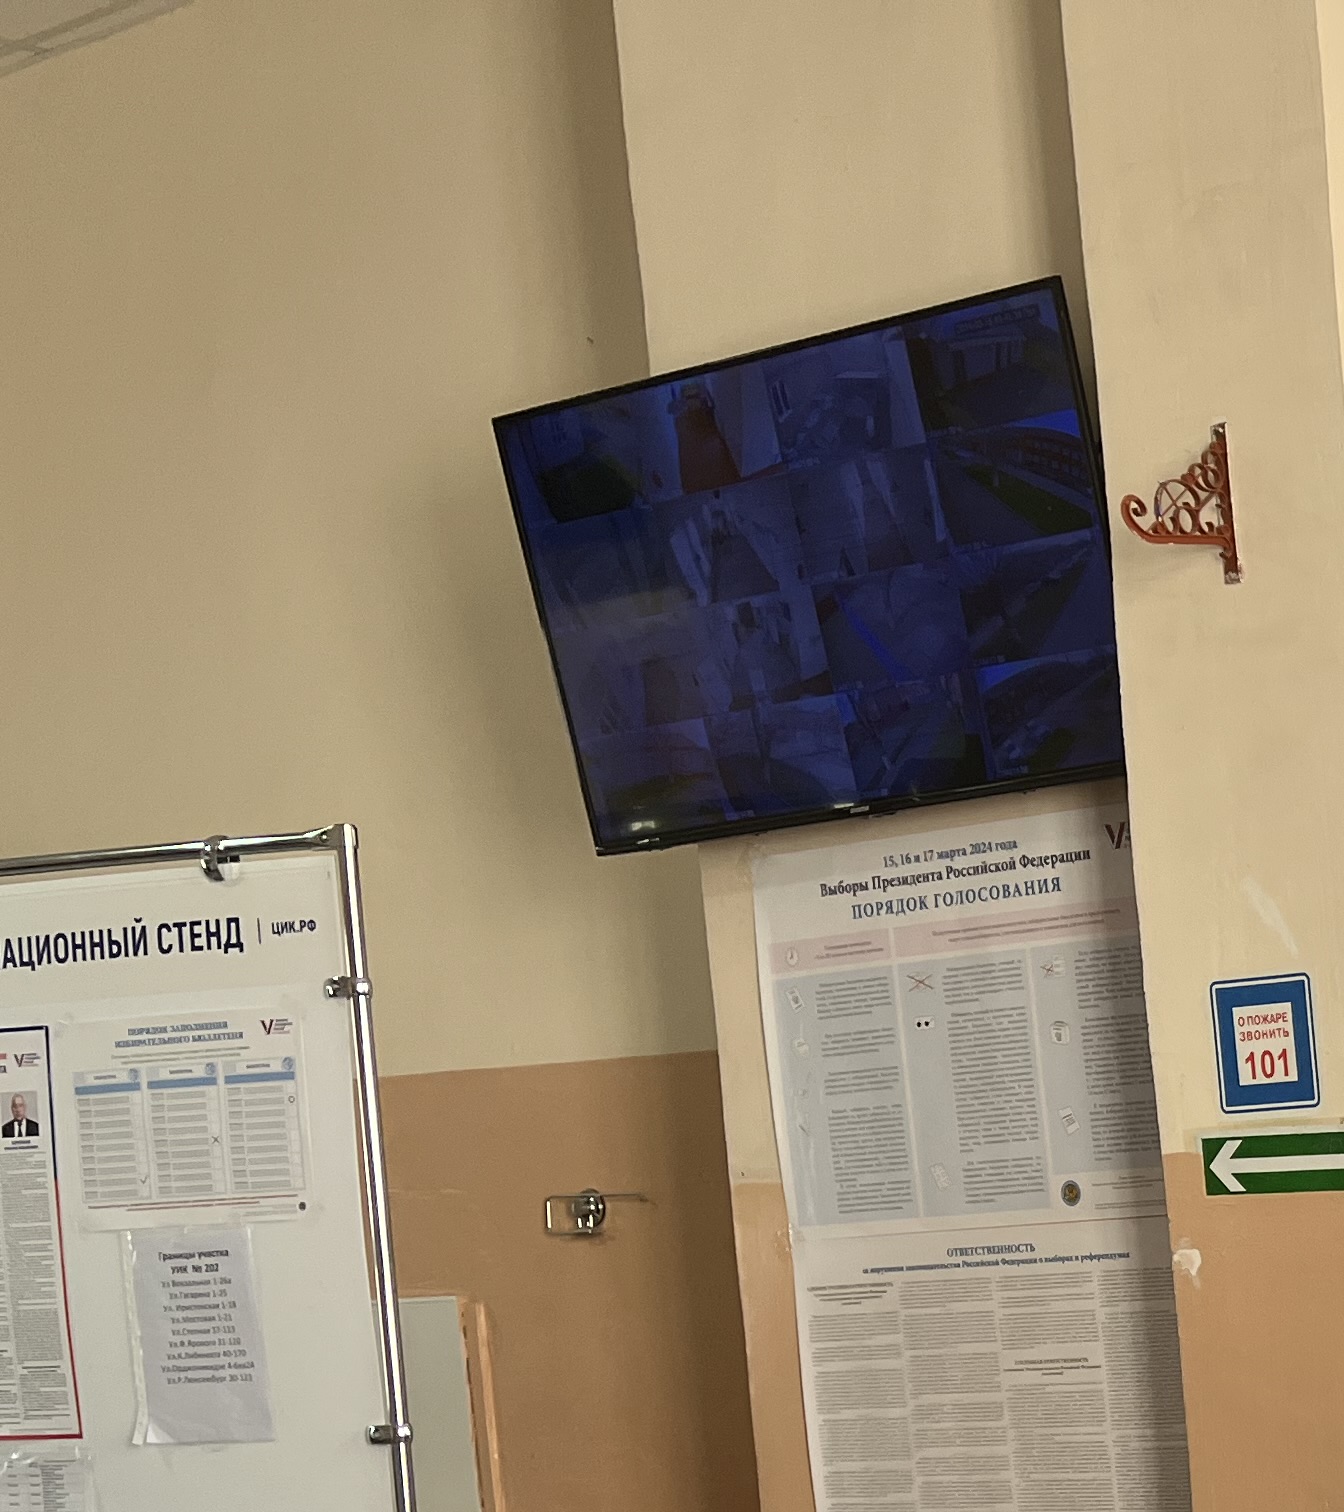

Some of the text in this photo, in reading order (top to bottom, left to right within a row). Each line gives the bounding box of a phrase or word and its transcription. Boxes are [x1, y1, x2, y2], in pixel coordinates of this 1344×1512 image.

[883, 855, 898, 868] 15,
[900, 853, 911, 865] 16
[923, 850, 933, 862] 17
[936, 847, 967, 861] марта
[970, 842, 992, 855] 2024
[995, 840, 1017, 851] года
[820, 850, 1091, 897] Выборы Президента Российской Федерации
[852, 877, 1062, 919] ПОРЯДОК ГОЛОСОВАНИЯ
[2, 917, 317, 972] АЦИОННЫЙ СТЕНД ЦИК.РФ
[1238, 1012, 1289, 1027] О ПОЖАРЕ
[1239, 1027, 1289, 1042] ЗВОНИТЬ
[1244, 1048, 1289, 1080] 101
[947, 1243, 1035, 1257] ОТВЕТСТВЕННОСТЬ
[171, 1263, 219, 1274] УИК № 202
